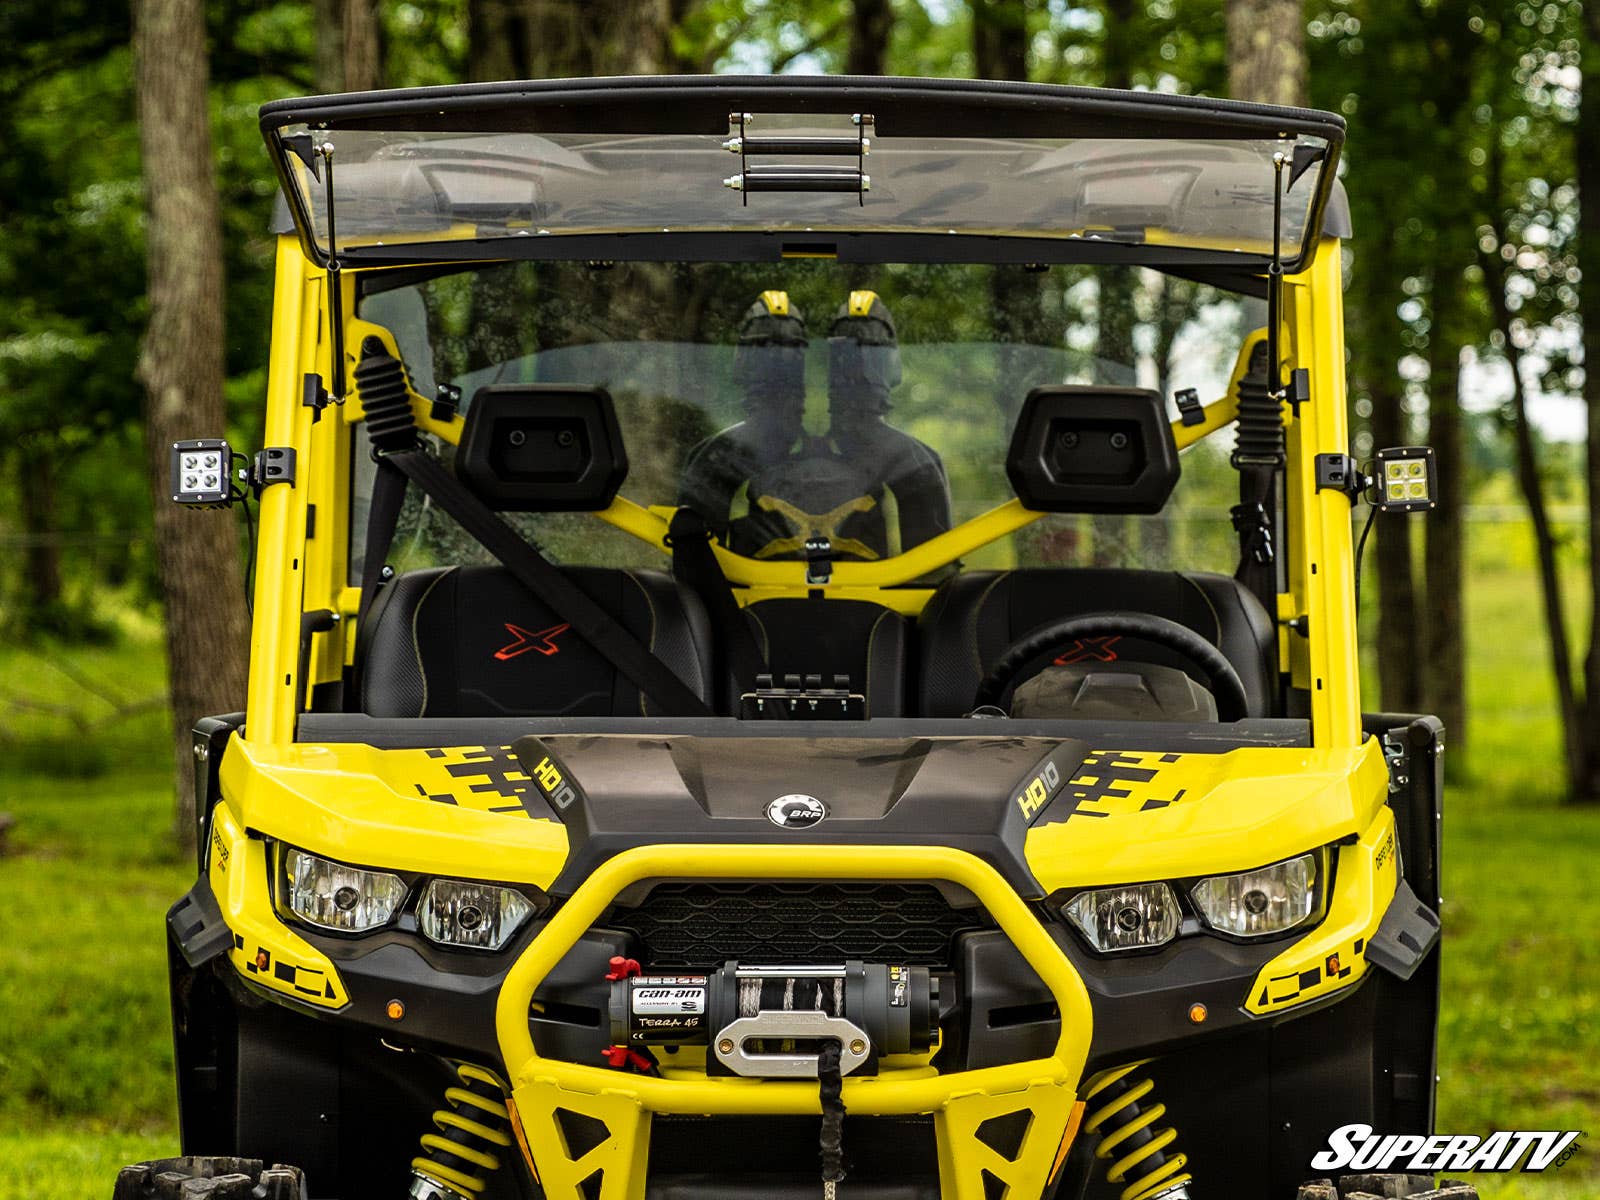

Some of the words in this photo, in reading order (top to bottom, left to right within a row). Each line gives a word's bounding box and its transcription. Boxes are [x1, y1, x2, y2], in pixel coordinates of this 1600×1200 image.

[533, 756, 576, 809] HD10
[1017, 760, 1060, 820] HD10
[789, 809, 822, 818] BRP
[684, 1017, 699, 1027] 45
